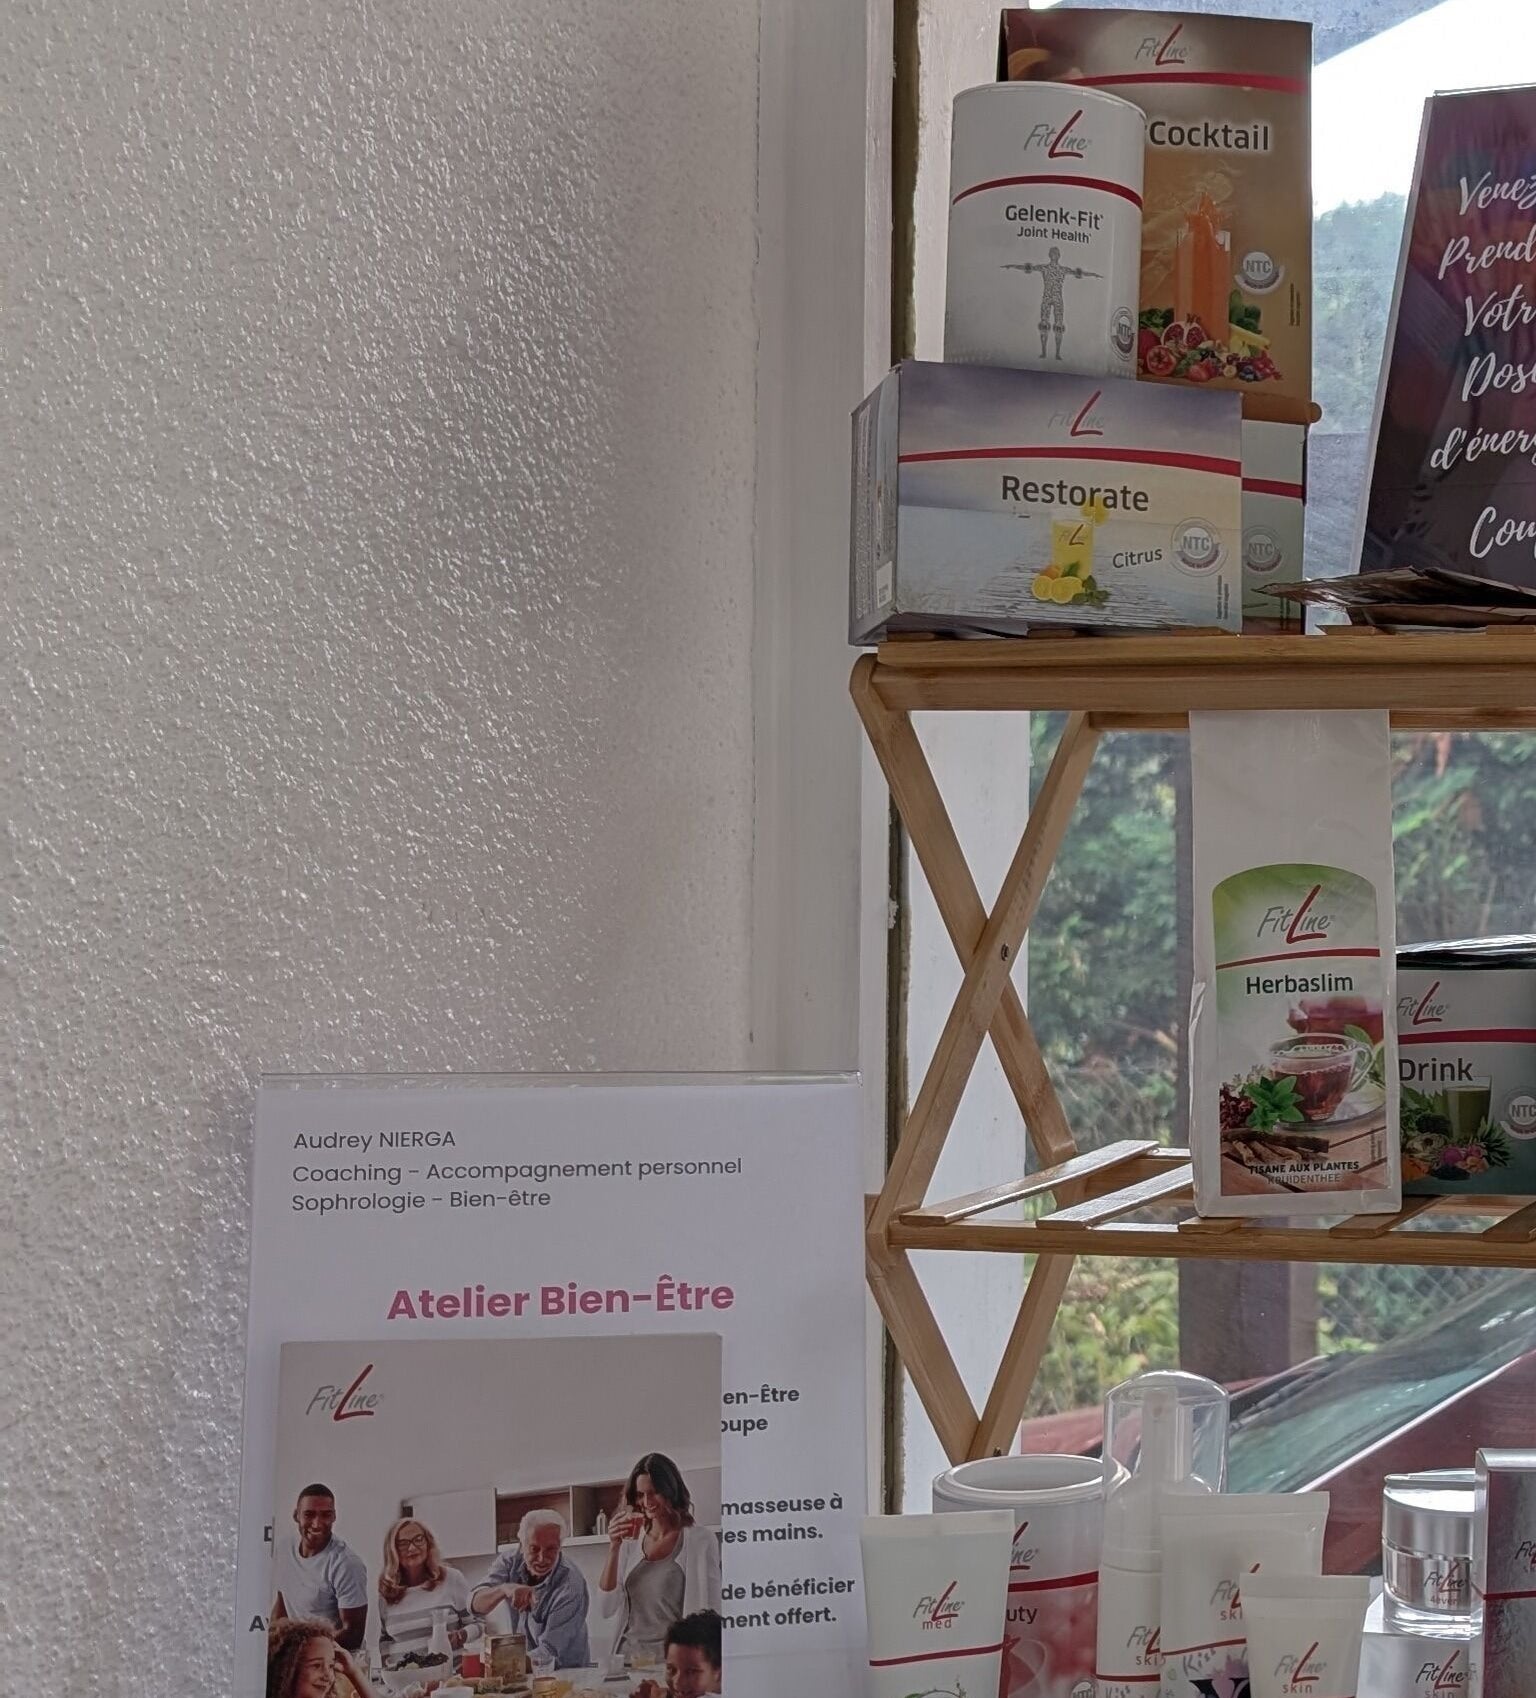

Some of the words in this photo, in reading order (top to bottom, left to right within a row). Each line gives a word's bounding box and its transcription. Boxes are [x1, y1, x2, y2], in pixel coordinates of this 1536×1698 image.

[1135, 23, 1190, 65] FitLine
[1023, 109, 1091, 159] FitLine
[1148, 120, 1270, 151] Cocktail
[1005, 203, 1101, 231] Gelenk-Fit
[1017, 226, 1049, 240] Joint
[1051, 229, 1090, 243] Health
[1246, 260, 1272, 274] NTC
[1001, 475, 1149, 512] Restorate
[1183, 535, 1210, 551] NTC
[1248, 542, 1273, 556] NTC
[1112, 547, 1163, 569] Citrus
[1257, 884, 1334, 944] FitLine
[1246, 973, 1354, 995] Herbaslim
[1397, 981, 1449, 1026] FitLine
[1399, 1058, 1473, 1082] Drink
[1511, 1103, 1536, 1118] NTC
[293, 1130, 372, 1152] Audrey
[379, 1131, 455, 1148] NIERGA
[292, 1164, 401, 1185] Coaching
[426, 1159, 632, 1183] Accompagnement
[638, 1157, 742, 1178] personnel
[1250, 1164, 1286, 1174] TISANE
[1289, 1163, 1311, 1172] AUX
[1313, 1161, 1360, 1171] PLANTES
[291, 1192, 425, 1215] Sophrologie
[449, 1188, 551, 1208] Bien-être
[387, 1286, 530, 1320] Atelier
[540, 1274, 735, 1316] Bien-Être
[306, 1364, 383, 1421] FitLine
[721, 1498, 825, 1515] masseuse
[830, 1492, 843, 1510] à
[752, 1523, 823, 1542] mains.
[721, 1584, 746, 1600] de
[752, 1577, 855, 1598] bénéficier
[1424, 1561, 1466, 1593] FitLine
[912, 1580, 965, 1623] FitLine
[774, 1607, 837, 1625] offert.
[922, 1617, 953, 1630] med
[1274, 1641, 1325, 1684] FitLine
[1415, 1650, 1465, 1690] FitLine
[1283, 1684, 1313, 1695] skin
